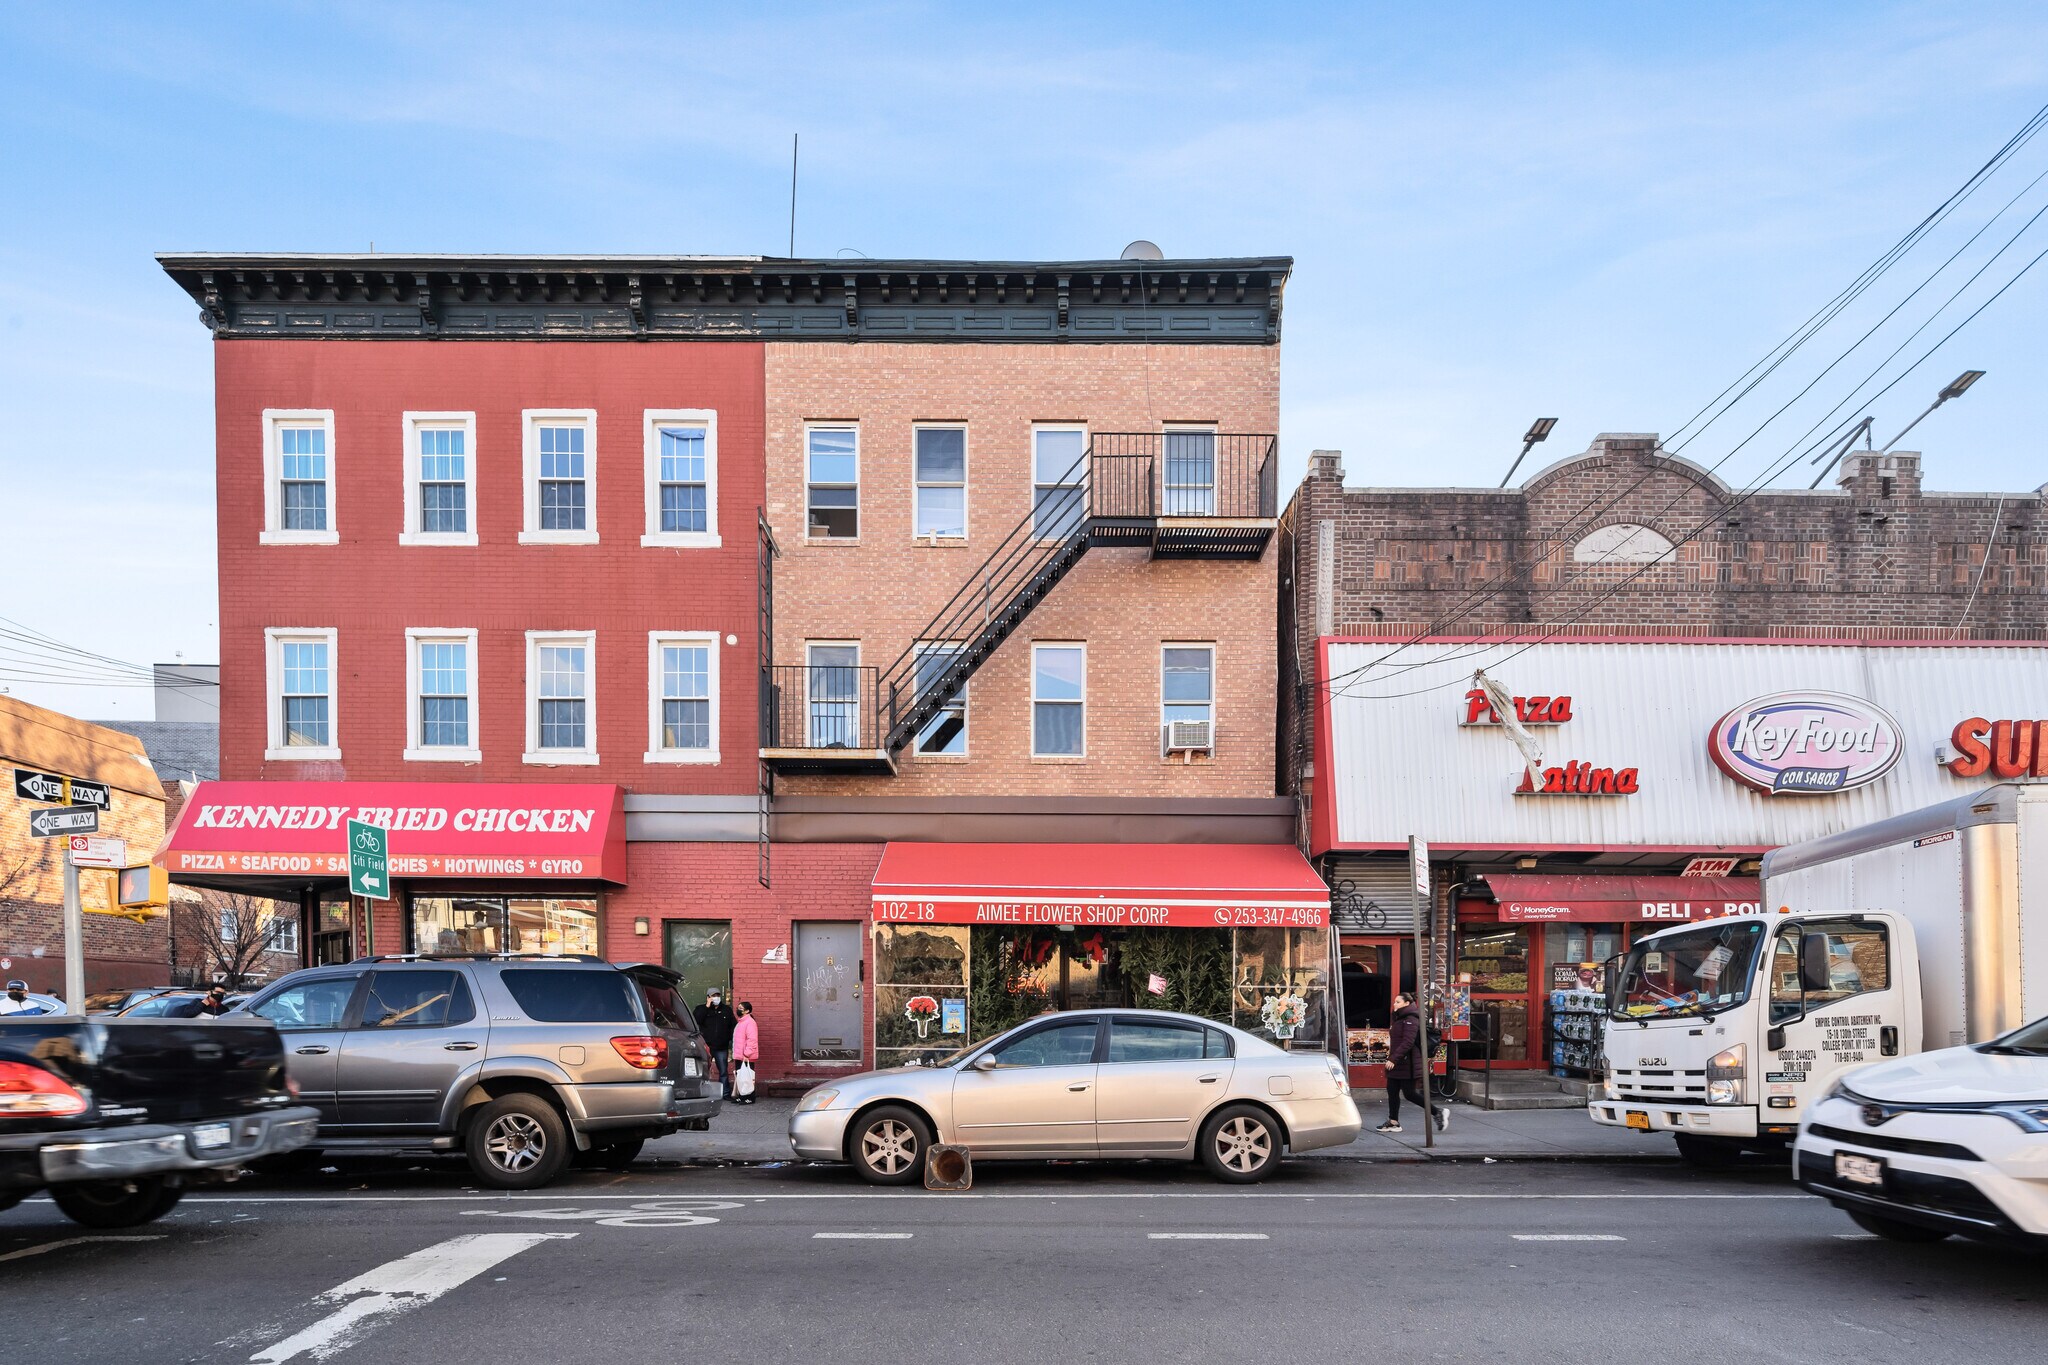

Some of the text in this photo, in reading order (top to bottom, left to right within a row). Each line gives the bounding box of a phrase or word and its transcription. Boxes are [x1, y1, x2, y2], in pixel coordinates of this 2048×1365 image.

[1781, 770, 1840, 787] CON SABOR
[31, 780, 98, 802] ONE WAY
[39, 813, 93, 828] ONE WAY
[193, 805, 595, 833] KENNEDY FRIED CHICKEN
[1920, 832, 1953, 847] MORGAN
[181, 854, 583, 874] PIZZA SEAFOOD SACHES HOTWINGS GYRO
[353, 853, 385, 872] Citi Field
[1687, 860, 1733, 872] ATM
[880, 901, 1321, 925] 102-18 AIMEE FLOWER SHOP CORP. 253-347-4966
[1641, 902, 1691, 918] DELI
[1815, 1017, 1830, 1028] EMPIRE
[1831, 1016, 1850, 1027] CONTROL
[1851, 1015, 1873, 1026] ABATEMENT
[1852, 1028, 1867, 1039] STREET
[1822, 1040, 1841, 1051] COLLEGE
[1856, 1039, 1862, 1050] NY
[1638, 1057, 1668, 1066] ISUZU
